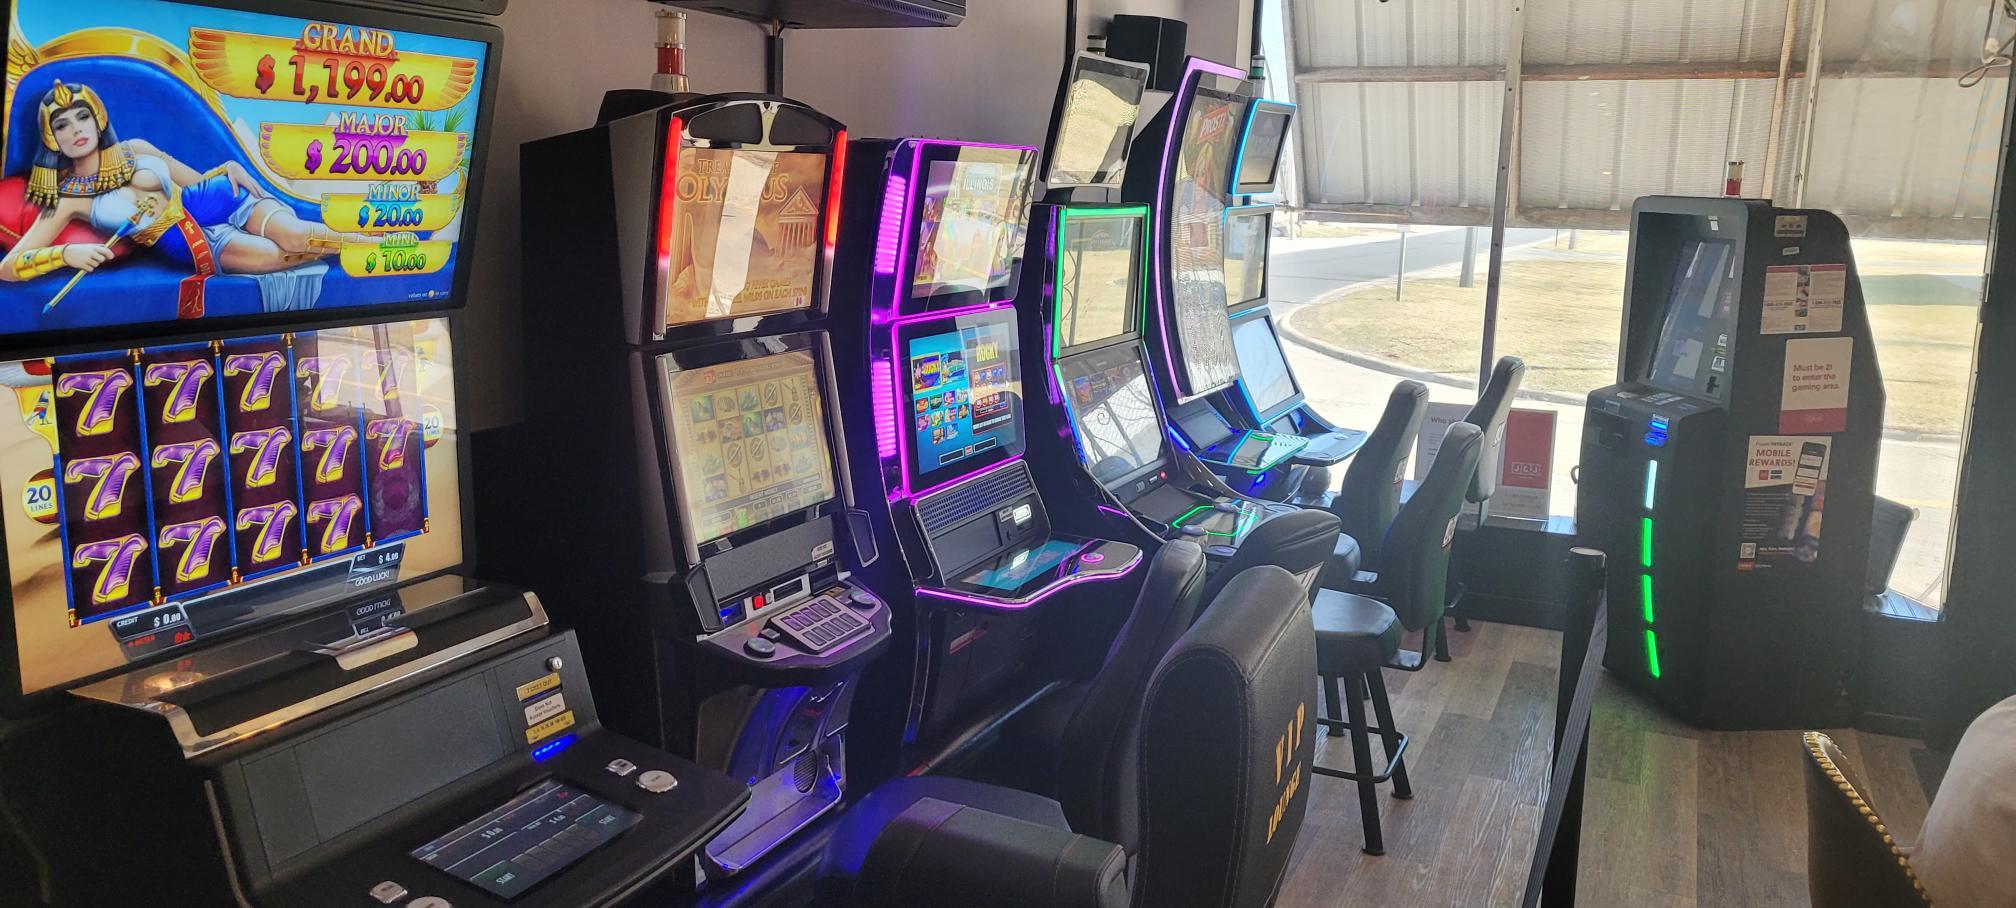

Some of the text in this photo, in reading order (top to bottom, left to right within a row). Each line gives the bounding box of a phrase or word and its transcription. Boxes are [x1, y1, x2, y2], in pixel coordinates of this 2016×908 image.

[303, 23, 394, 57] GRAND
[338, 111, 407, 136] MAJOR
[368, 184, 420, 201] MINOR
[677, 171, 789, 203] OLYUS
[383, 232, 417, 247] MINI
[976, 342, 999, 362] ROCKY
[1793, 364, 1812, 372] Must
[56, 368, 133, 437] 7
[144, 358, 214, 425] 7
[223, 350, 287, 413] 7
[1792, 384, 1821, 392] gaming
[425, 416, 440, 430] 20
[1756, 449, 1792, 457] MOBILE
[1749, 459, 1796, 467] REWARDS!
[65, 451, 141, 521] 7
[151, 437, 221, 505] 7
[230, 425, 293, 489] 7
[302, 425, 357, 485] 7
[27, 485, 52, 504] 20
[30, 502, 53, 512] LINES
[72, 493, 363, 605] 7 7 7 7
[355, 576, 373, 587] GOOD
[116, 616, 139, 628] CREDIT
[1275, 702, 1305, 786] VIP
